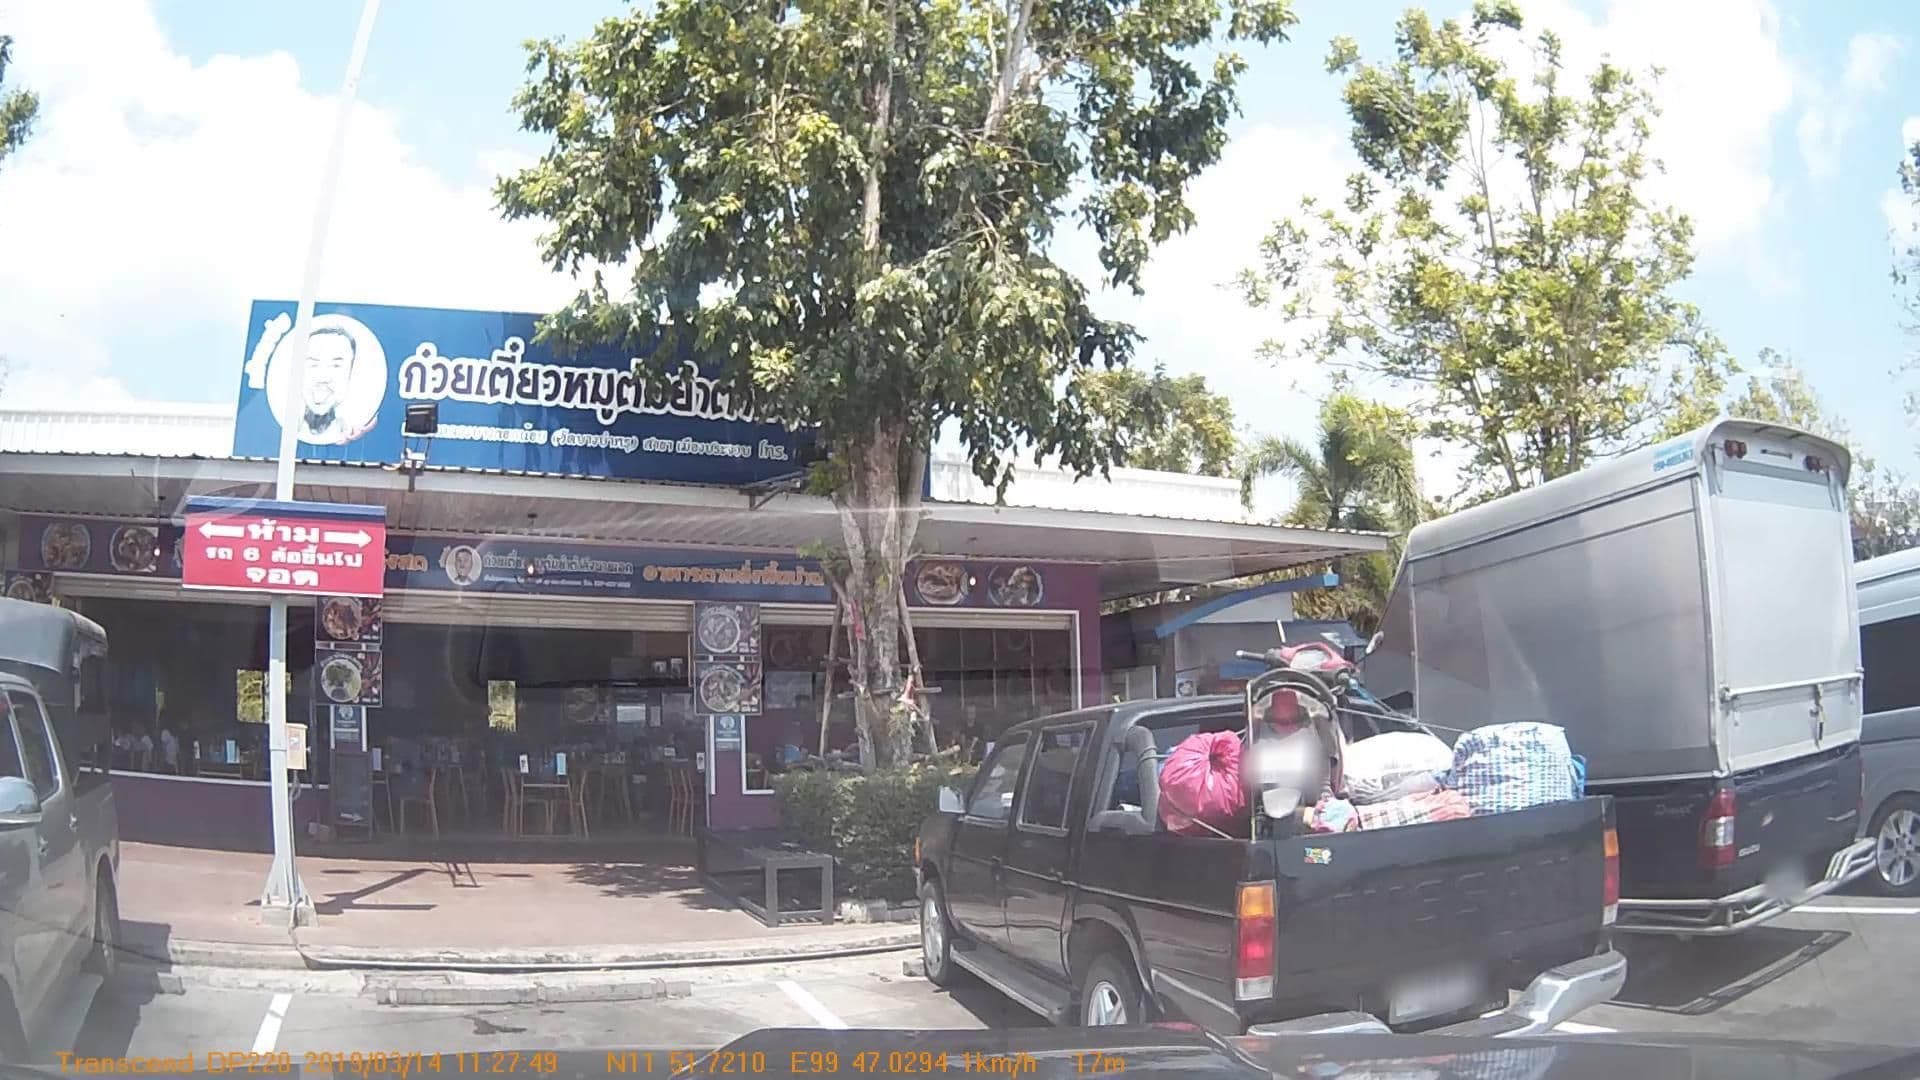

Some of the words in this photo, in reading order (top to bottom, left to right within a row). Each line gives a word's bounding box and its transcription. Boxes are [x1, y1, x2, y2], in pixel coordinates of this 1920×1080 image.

[758, 439, 789, 461] โทร.
[247, 519, 319, 544] ห้าม
[205, 545, 233, 561] รถ
[243, 546, 261, 562] 6
[271, 544, 364, 568] ล้อขึ้นไป
[246, 567, 319, 587] จอด
